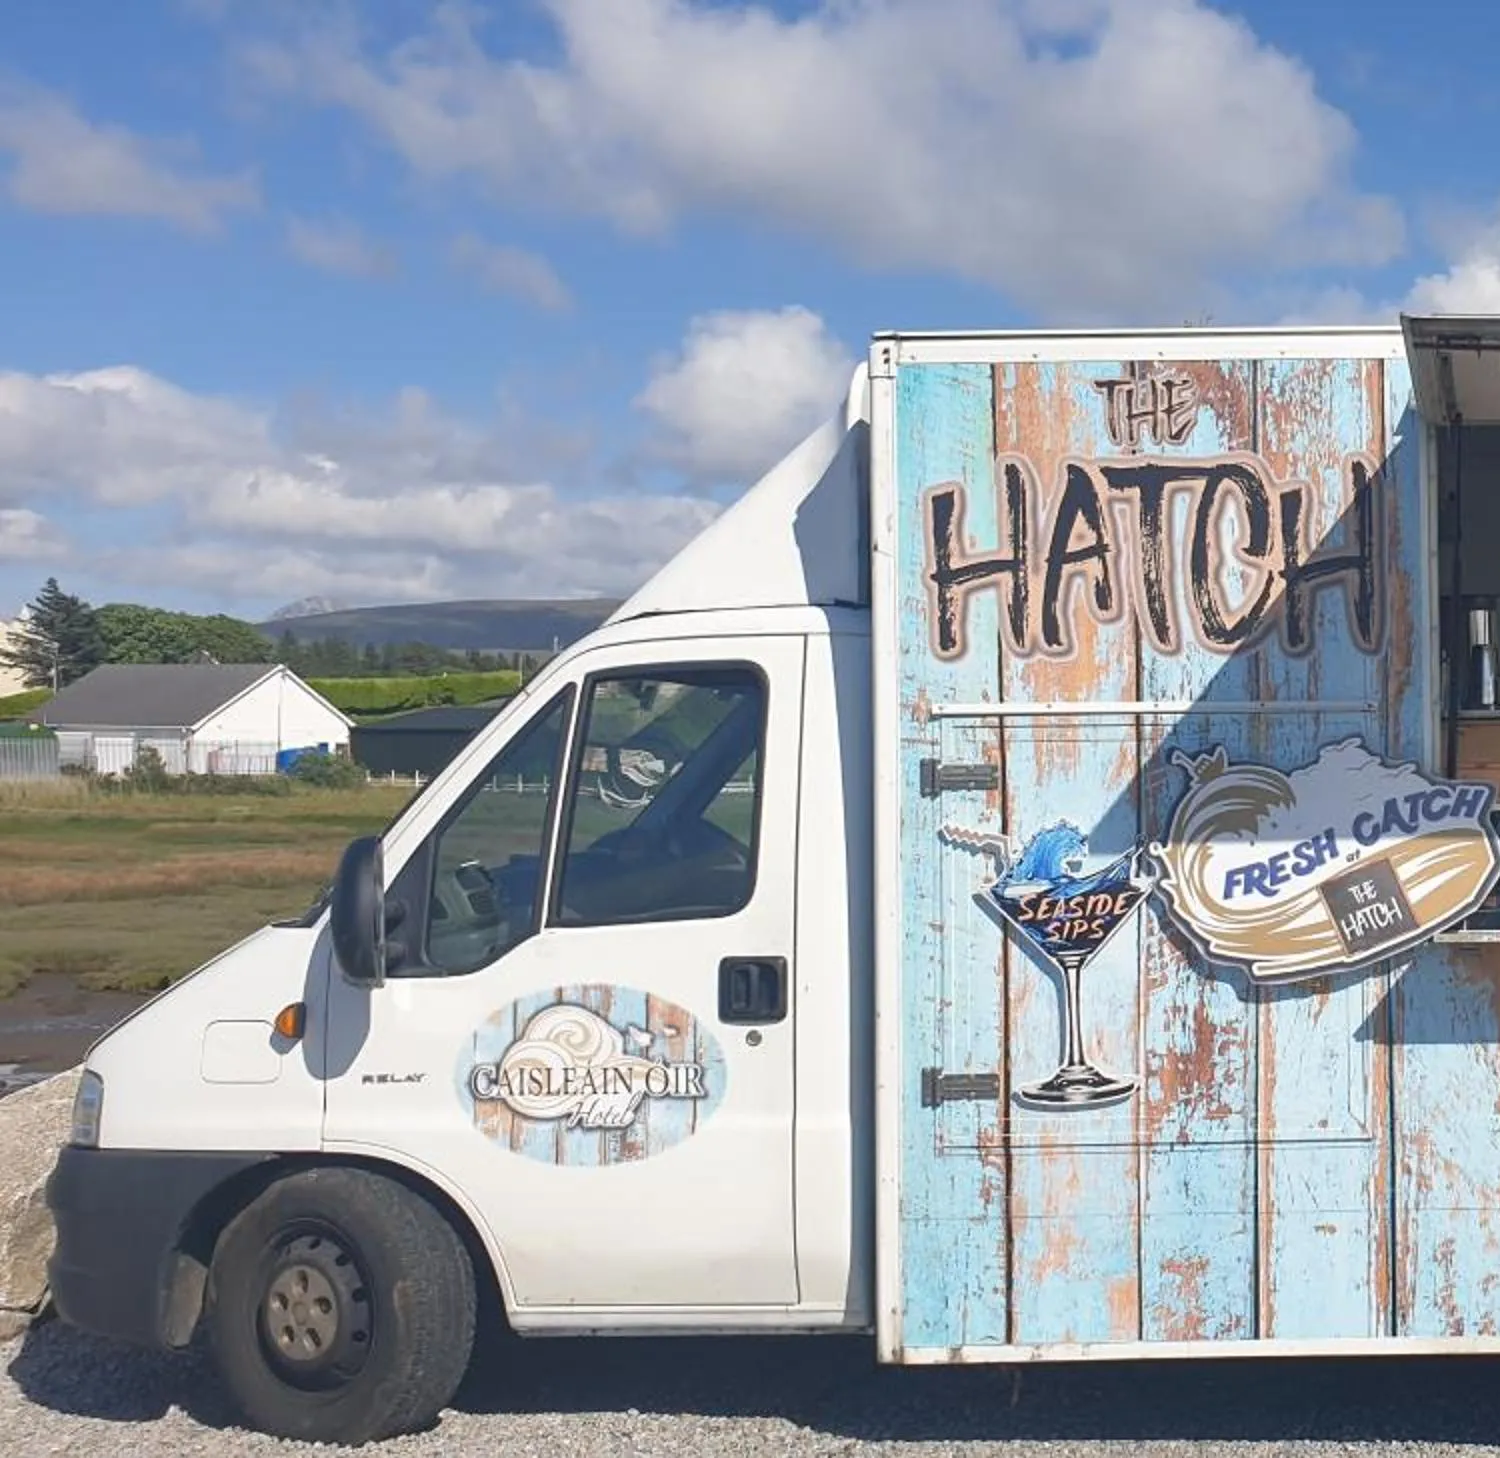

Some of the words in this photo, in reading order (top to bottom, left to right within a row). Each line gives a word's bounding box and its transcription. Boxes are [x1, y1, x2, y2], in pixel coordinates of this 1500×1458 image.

[1095, 379, 1197, 443] THE
[931, 460, 1376, 651] HATCH
[1223, 827, 1340, 900] FRESH
[1352, 788, 1486, 846] CATCH
[1018, 891, 1134, 921] SEASIDE
[1347, 879, 1377, 904] THE
[1045, 918, 1105, 941] SIPS
[1341, 896, 1403, 941] HATCH
[362, 1073, 426, 1085] RELAY
[568, 1090, 643, 1127] Hotel
